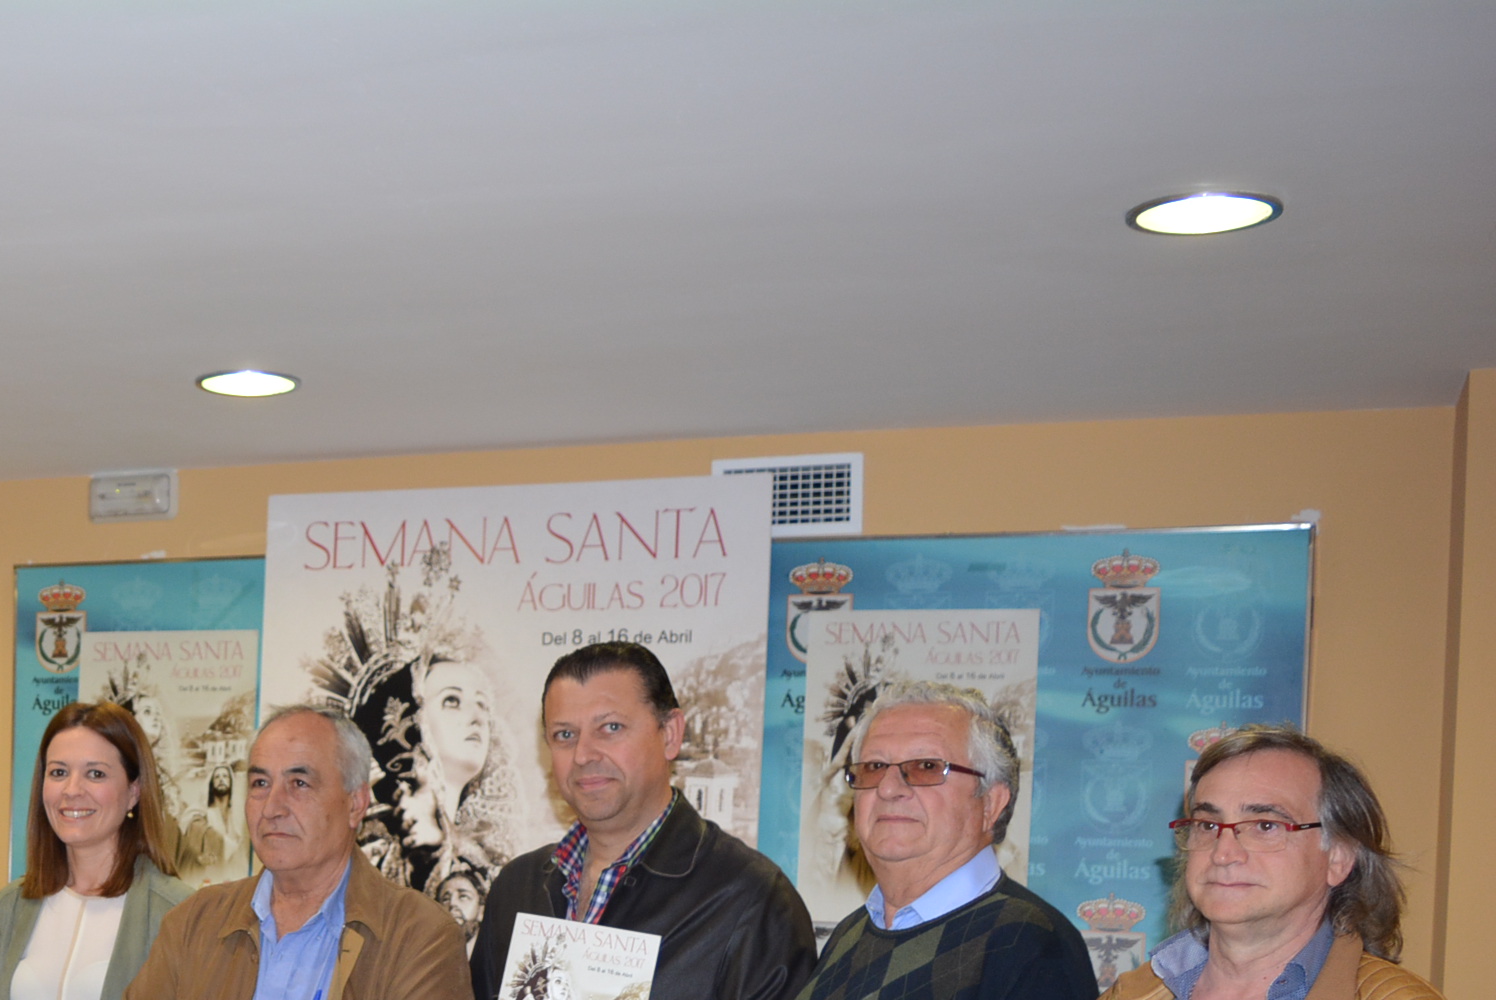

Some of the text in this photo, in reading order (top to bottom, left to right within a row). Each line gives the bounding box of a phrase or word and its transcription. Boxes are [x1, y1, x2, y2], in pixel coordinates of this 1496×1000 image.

[304, 507, 727, 571] SEMANA SANTA
[517, 572, 727, 611] ÁGUILAS 2017
[542, 628, 692, 646] Del 8 al 16 de Abril
[825, 621, 1020, 645] SEMANA SANTA
[93, 640, 244, 662] SEMANA SANTA
[1081, 666, 1160, 678] Ayuntamiento
[1113, 678, 1127, 689] de
[54, 686, 64, 695] de
[1082, 688, 1157, 713] Águilas
[1186, 688, 1264, 713] Águilas
[1074, 857, 1151, 885] Águilas
[521, 919, 647, 955] SEMANA SANTA
